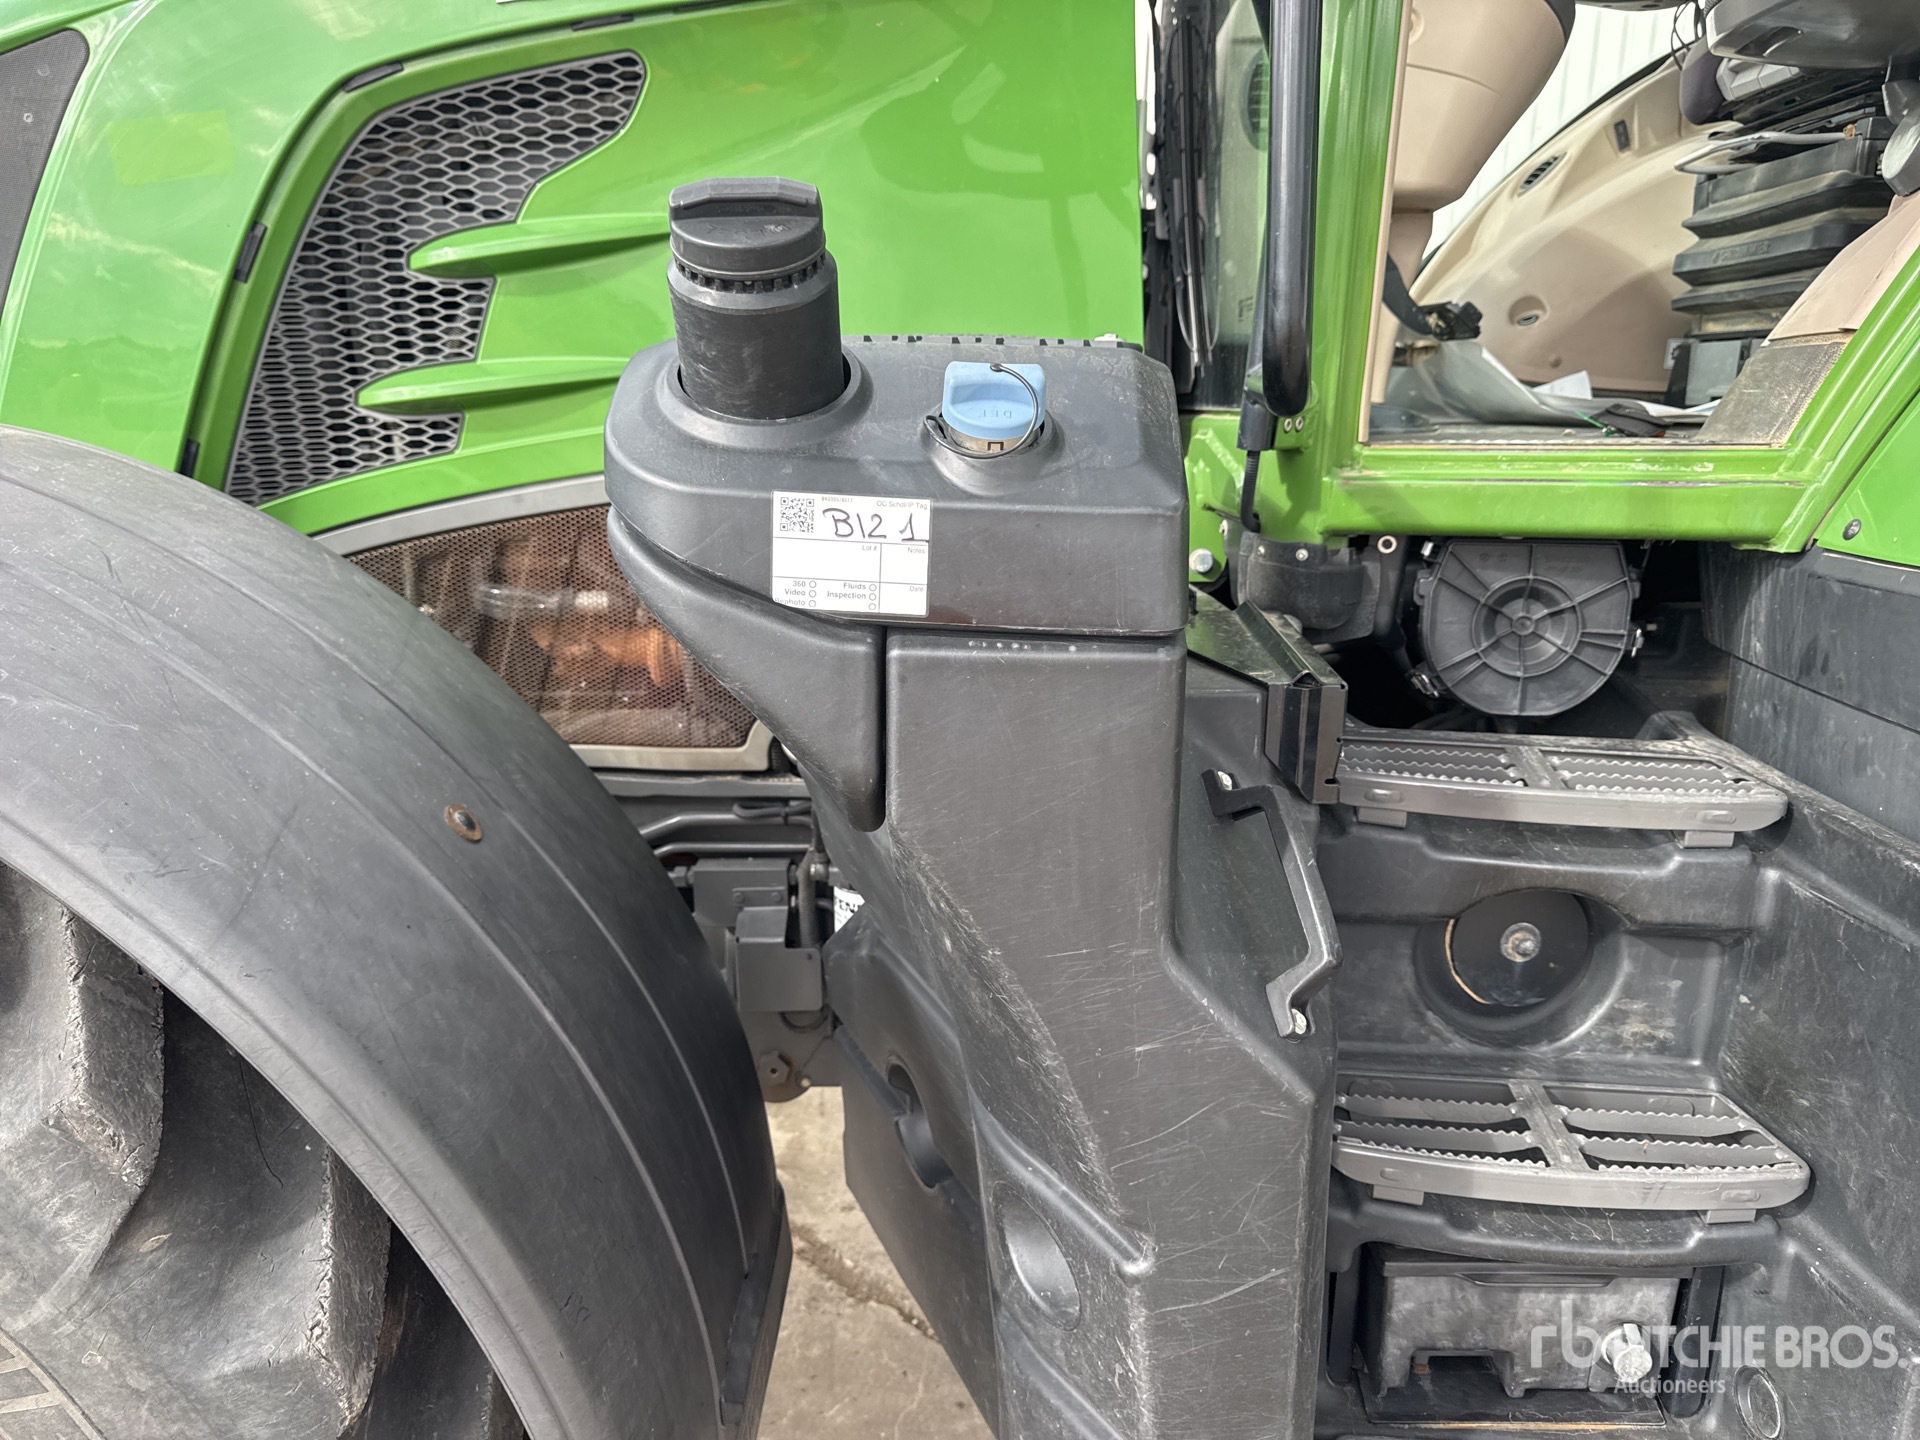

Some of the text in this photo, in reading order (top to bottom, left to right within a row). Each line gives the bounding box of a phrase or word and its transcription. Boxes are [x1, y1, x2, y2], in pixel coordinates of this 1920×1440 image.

[843, 582, 867, 590] Fluids
[784, 588, 806, 596] Video
[827, 590, 867, 599] Inspection
